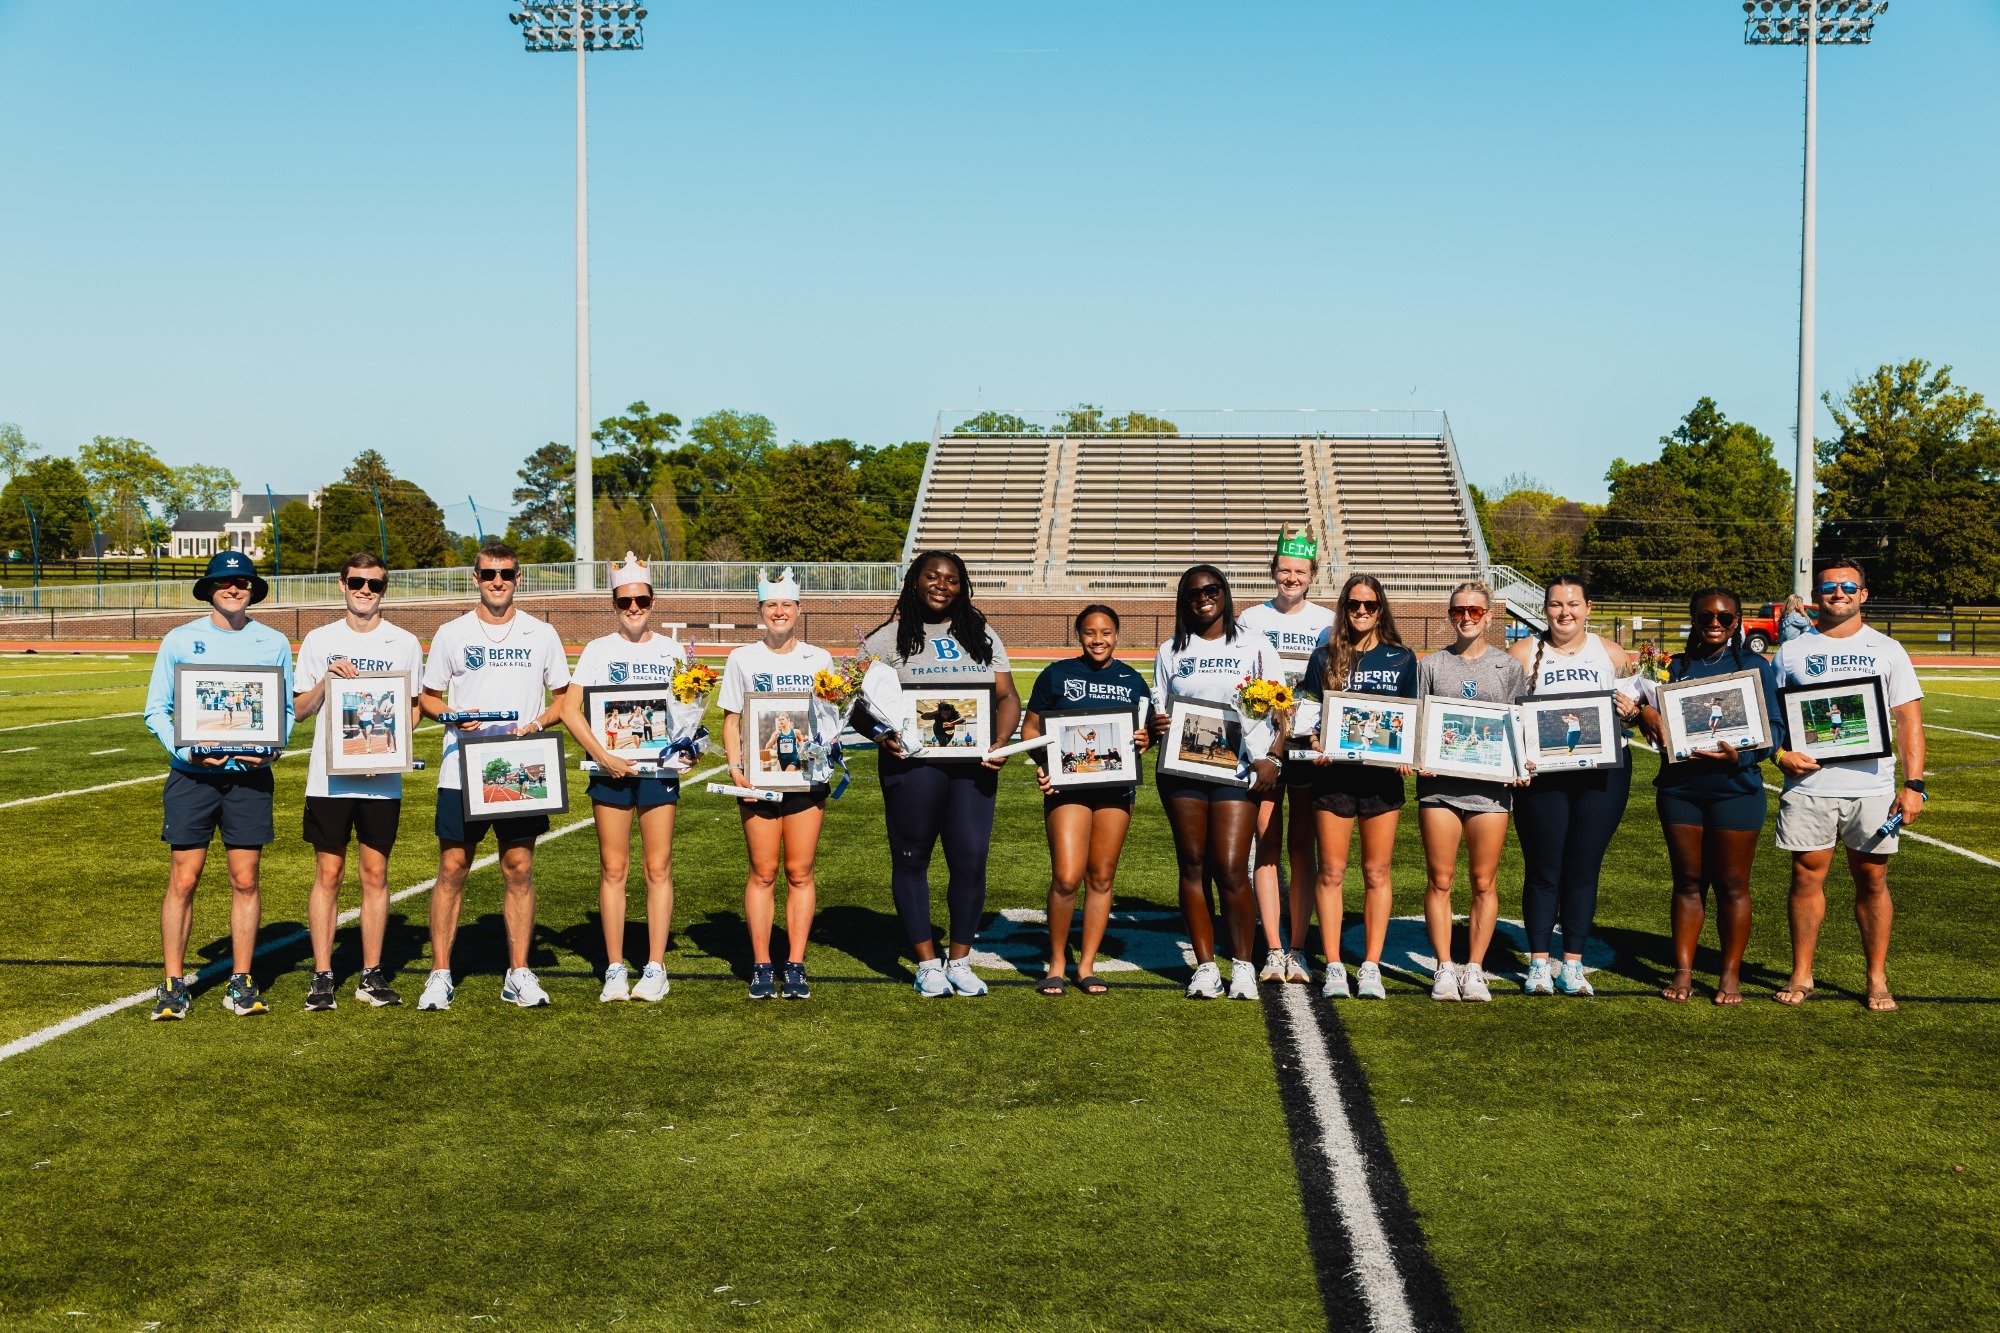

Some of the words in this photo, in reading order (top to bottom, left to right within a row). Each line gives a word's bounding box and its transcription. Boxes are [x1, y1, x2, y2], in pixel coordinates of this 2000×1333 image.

[1282, 541, 1316, 557] LEINE
[1283, 632, 1320, 647] BERRY
[193, 640, 206, 655] B
[488, 648, 532, 660] BERRY
[929, 637, 963, 662] B
[351, 658, 393, 671] BERRY
[1199, 658, 1241, 669] BERRY
[1830, 655, 1876, 667] BERRY
[632, 663, 672, 677] BERRY
[911, 666, 948, 676] TRACK
[952, 665, 959, 673] &
[962, 665, 987, 673] FIELD
[1859, 667, 1876, 675] FIELD
[1354, 670, 1400, 684] BERRY
[1544, 668, 1599, 686] BERRY
[1089, 682, 1132, 698] BERRY
[1382, 684, 1398, 692] FIELD
[1117, 695, 1132, 703] FIELD
